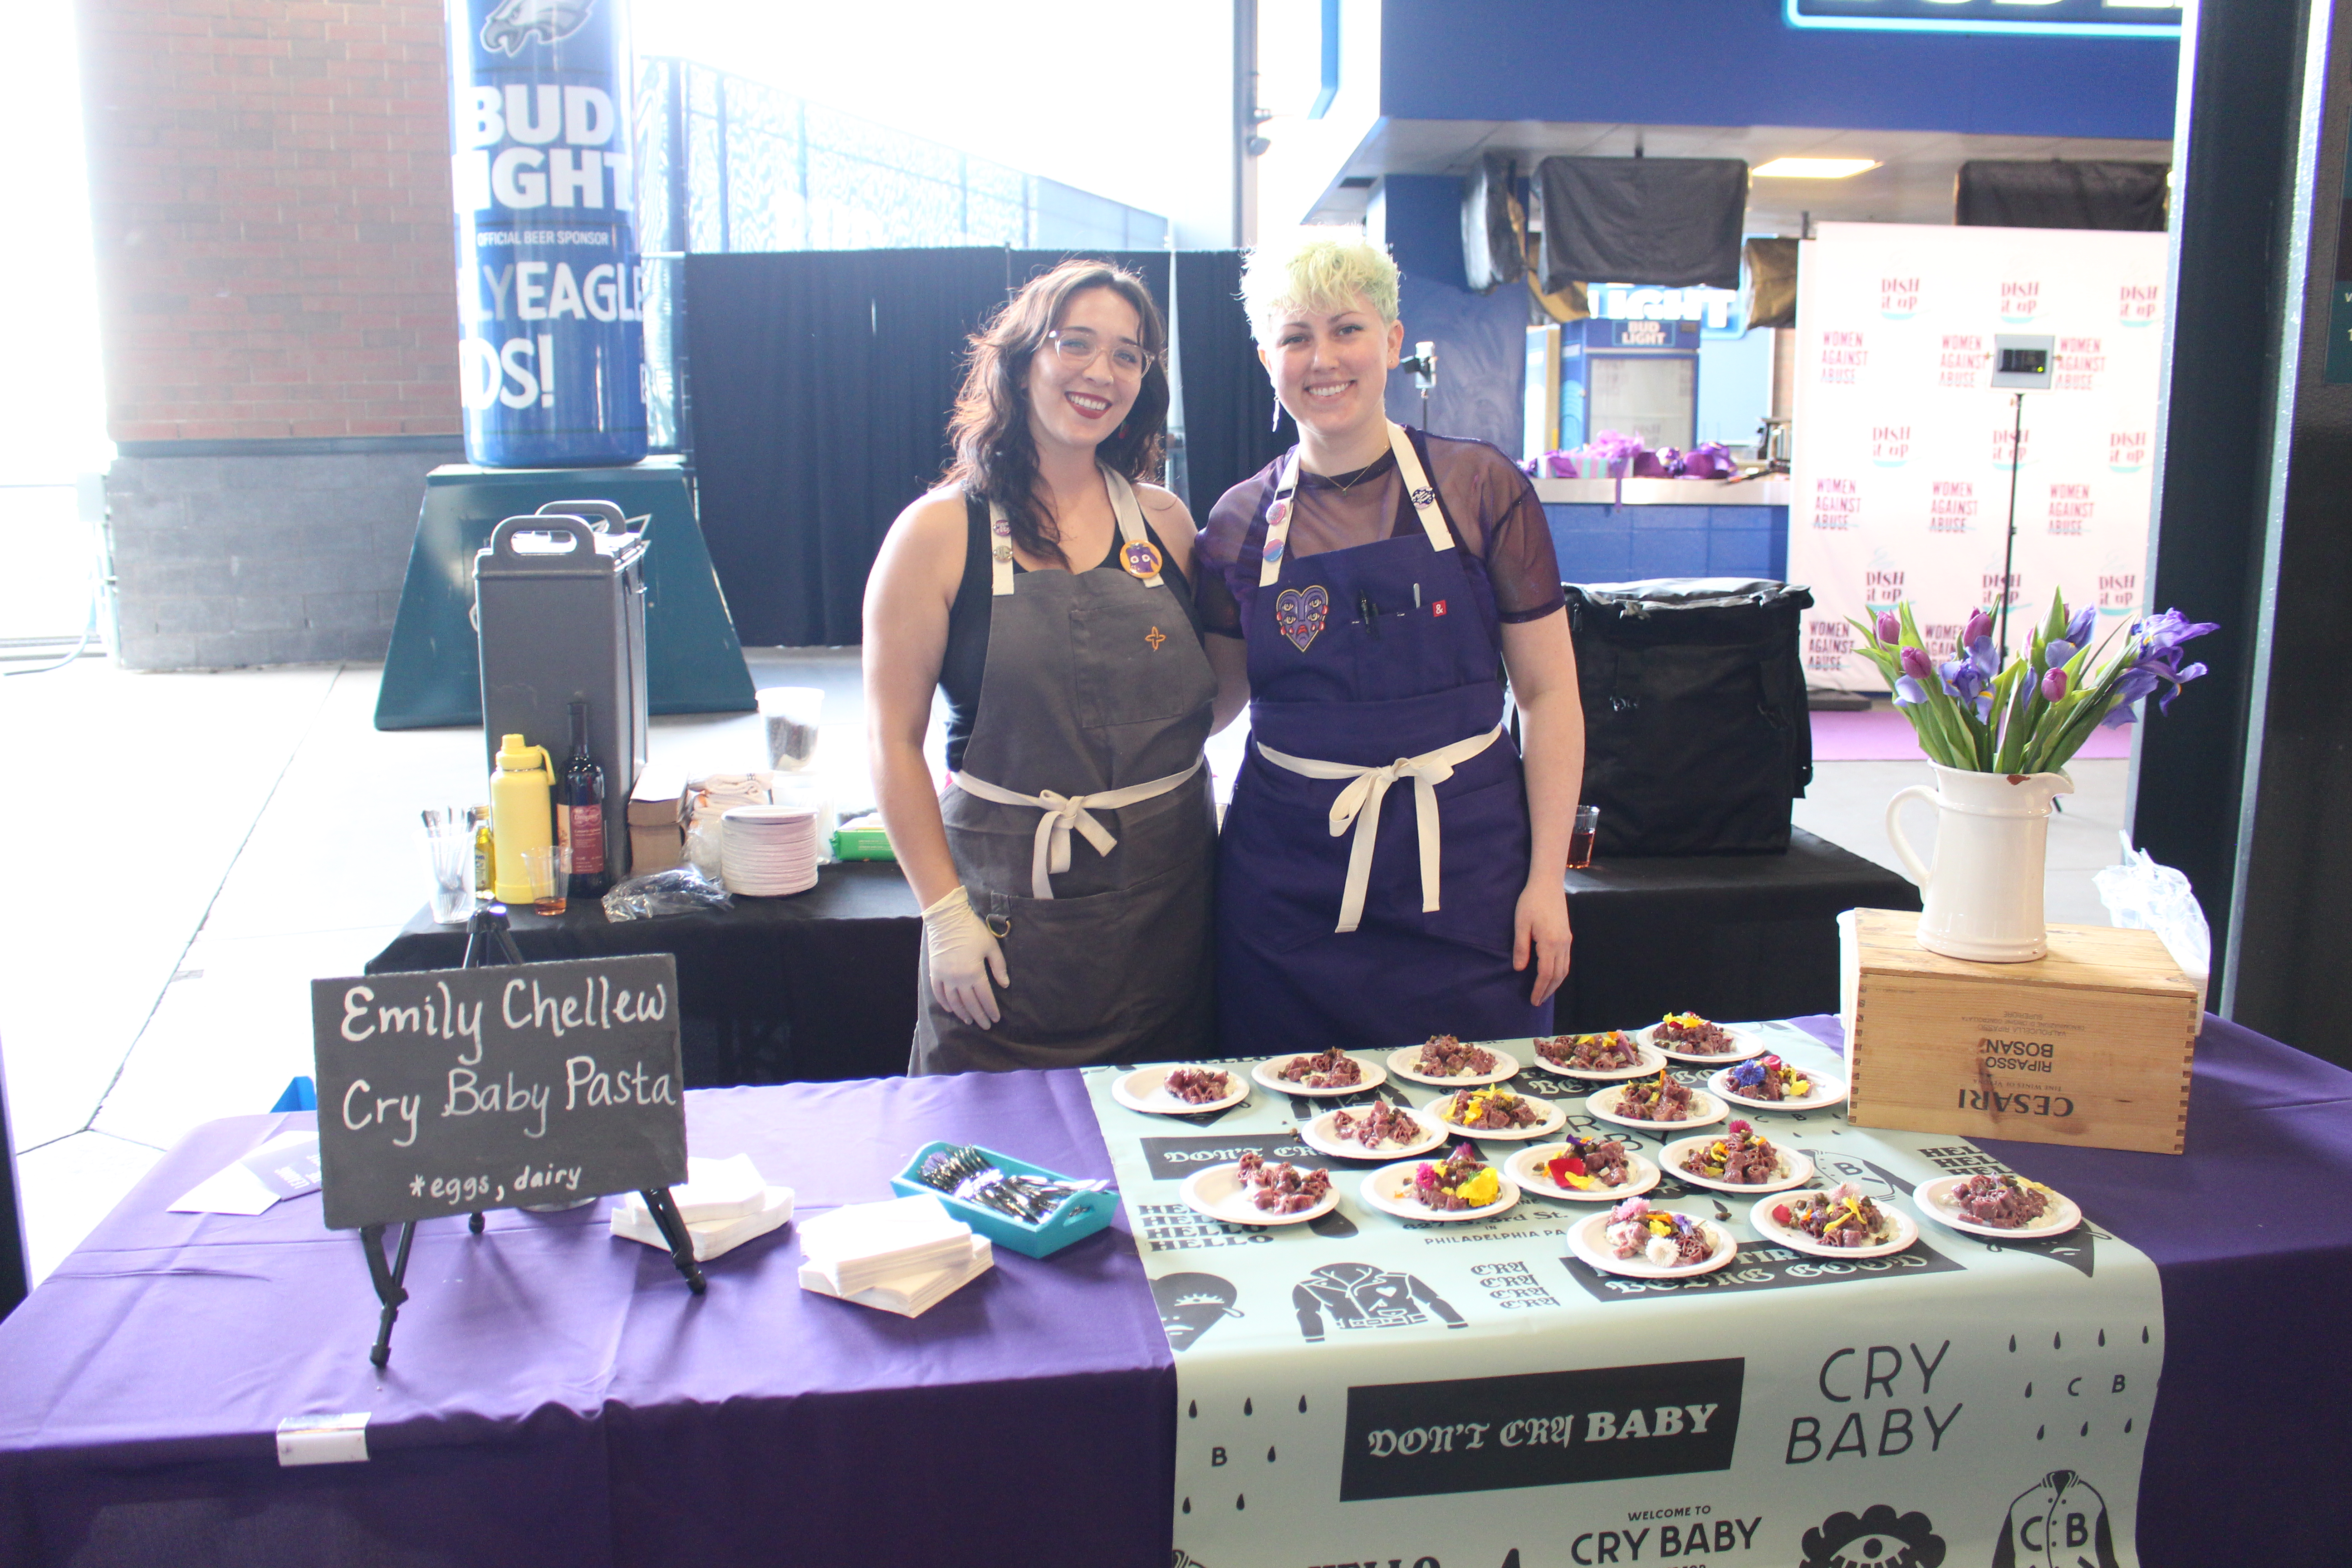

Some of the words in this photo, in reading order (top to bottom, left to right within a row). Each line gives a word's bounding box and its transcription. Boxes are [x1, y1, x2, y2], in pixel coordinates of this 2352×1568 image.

[467, 84, 614, 147] BUD
[477, 231, 521, 248] OFFICIAL
[524, 230, 554, 245] BEER
[557, 230, 609, 245] SPONSOR
[1882, 278, 1919, 294] DISH
[2001, 281, 2039, 297] DISH
[2121, 285, 2158, 301] DISH
[1628, 320, 1661, 333] BUD
[1621, 331, 1666, 345] LIGHT
[1823, 331, 1863, 347] WOMEN
[1942, 335, 1982, 350] WOMEN
[2060, 338, 2101, 353] WOMEN
[1822, 349, 1868, 366] AGAINST
[1940, 353, 1986, 369] AGAINST
[2058, 356, 2106, 372] AGAINST
[1821, 368, 1856, 384] ABUSE
[1939, 371, 1975, 387] ABUSE
[2055, 374, 2093, 390] ABUSE
[1873, 426, 1911, 442] DISH
[2111, 431, 2146, 447] DISH
[1817, 478, 1857, 495] WOMEN
[1933, 481, 1973, 497] WOMEN
[2051, 484, 2090, 500] WOMEN
[1815, 496, 1861, 513] AGAINST
[1931, 500, 1978, 516] AGAINST
[2049, 502, 2095, 518] AGAINST
[1814, 514, 1849, 530] ABUSE
[1930, 517, 1966, 534] ABUSE
[2048, 519, 2082, 536] ABUSE
[1867, 571, 1904, 586] DISH
[2100, 575, 2135, 590] DISH
[1809, 621, 1849, 637] WOMEN
[1809, 638, 1854, 654] AGAINST
[1808, 656, 1841, 671] ABUSE
[341, 981, 483, 1065] Emily
[503, 976, 668, 1037] Chellew
[2013, 1027, 2067, 1037] VALPOLICELLA
[1986, 1039, 2054, 1058] BOSAN
[1985, 1056, 2052, 1073] RIPASSO
[343, 1079, 421, 1147] Cry
[441, 1068, 550, 1138] Baby
[565, 1056, 677, 1111] Pasta
[1958, 1088, 2074, 1117] CESARI
[1273, 1145, 1327, 1157] CR
[514, 1165, 582, 1191] dairy
[1533, 1210, 1568, 1220] St.
[1144, 1224, 1268, 1240] HELLO
[1424, 1231, 1540, 1245] PHILADELPHIA
[1544, 1229, 1567, 1237] PA
[1148, 1235, 1274, 1252] HELLO
[1470, 1261, 1530, 1276] CRY
[1784, 1255, 1928, 1278] GOOD
[1480, 1274, 1539, 1288] CRY
[1490, 1286, 1550, 1299] CRY
[1499, 1296, 1561, 1309] CRY
[1819, 1340, 1950, 1402] CRY
[2068, 1377, 2082, 1396] C
[2111, 1374, 2126, 1394] B
[1368, 1423, 1490, 1458] DON'T
[1499, 1414, 1574, 1449] CRY
[1584, 1403, 1719, 1443] BABY
[1785, 1403, 1963, 1465] BABY
[1211, 1446, 1228, 1467] B
[1627, 1507, 1692, 1522] WELCOME
[1695, 1505, 1711, 1516] TO
[2066, 1513, 2088, 1548] B
[1571, 1527, 1650, 1566] CRY
[1659, 1516, 1762, 1558] BABY
